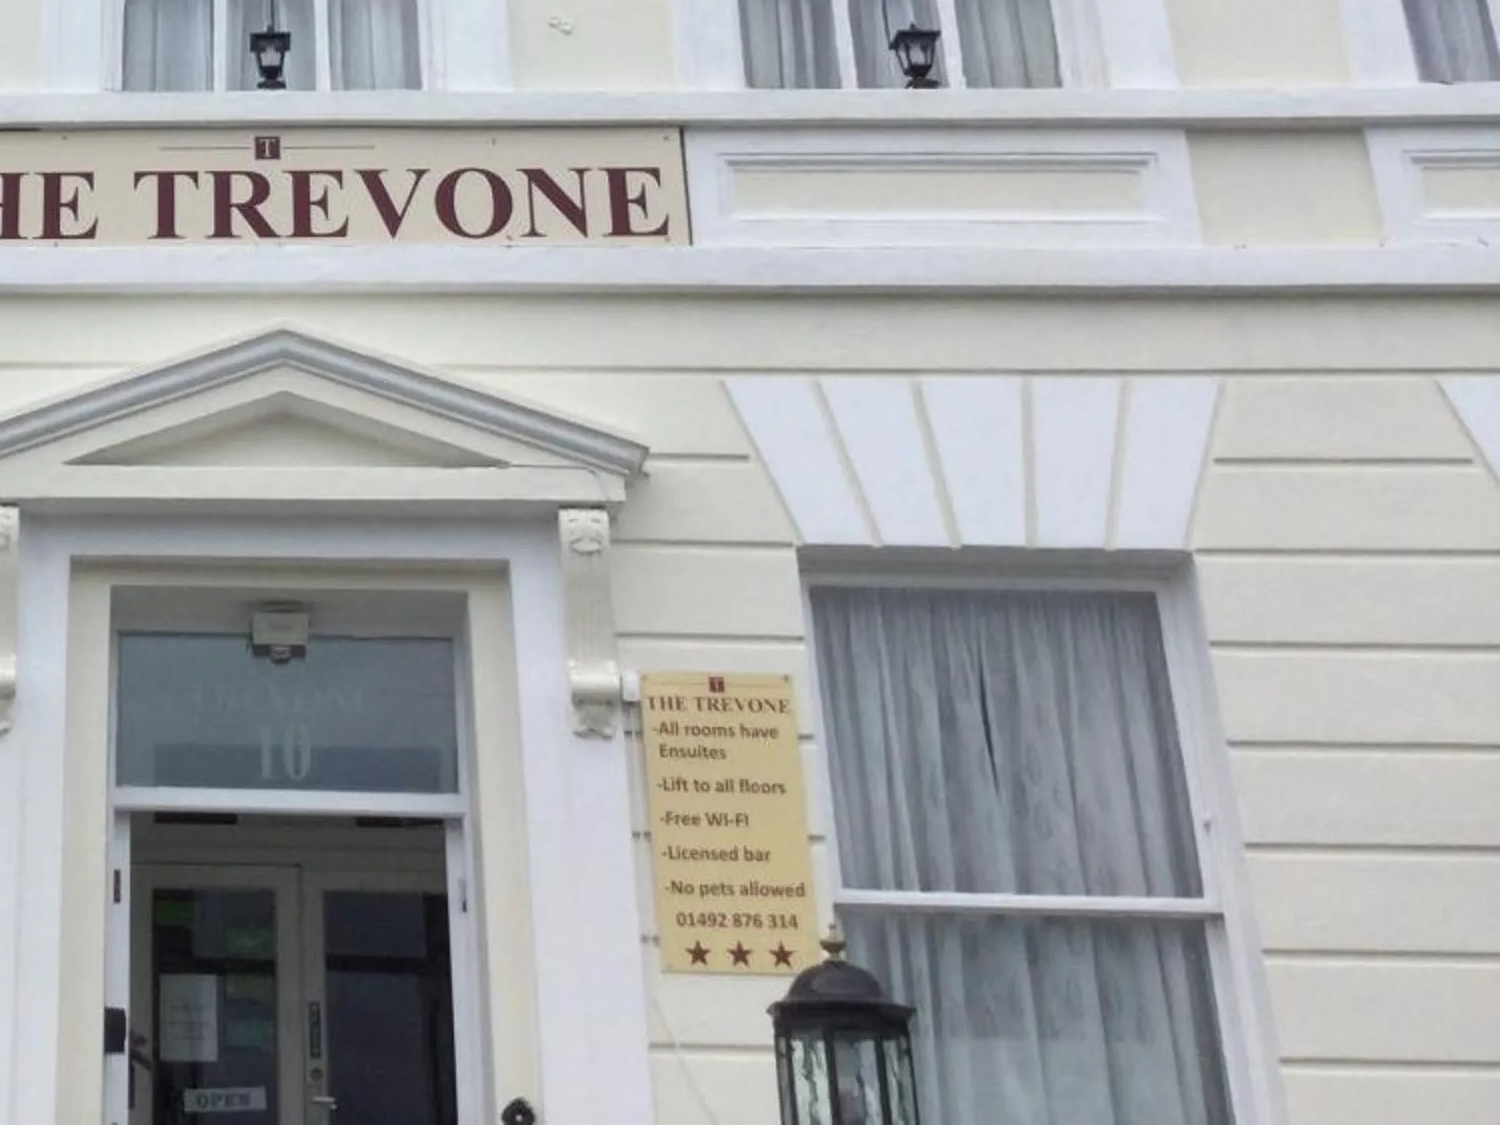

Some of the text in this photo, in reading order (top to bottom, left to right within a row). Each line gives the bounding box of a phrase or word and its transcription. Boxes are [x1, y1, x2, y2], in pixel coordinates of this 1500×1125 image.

[133, 166, 671, 241] TREVONE
[647, 695, 790, 714] THE TREVONE
[683, 724, 737, 737] rooms
[739, 723, 779, 740] have
[258, 724, 312, 782] 10
[658, 742, 728, 760] Ensuites
[692, 778, 711, 793] to
[715, 778, 735, 793] all
[738, 778, 788, 795] floors
[742, 845, 772, 863] bar
[698, 881, 736, 898] pets
[738, 880, 806, 898] allowed
[675, 911, 799, 930] 01492 876 314
[195, 1090, 251, 1109] OPEN
